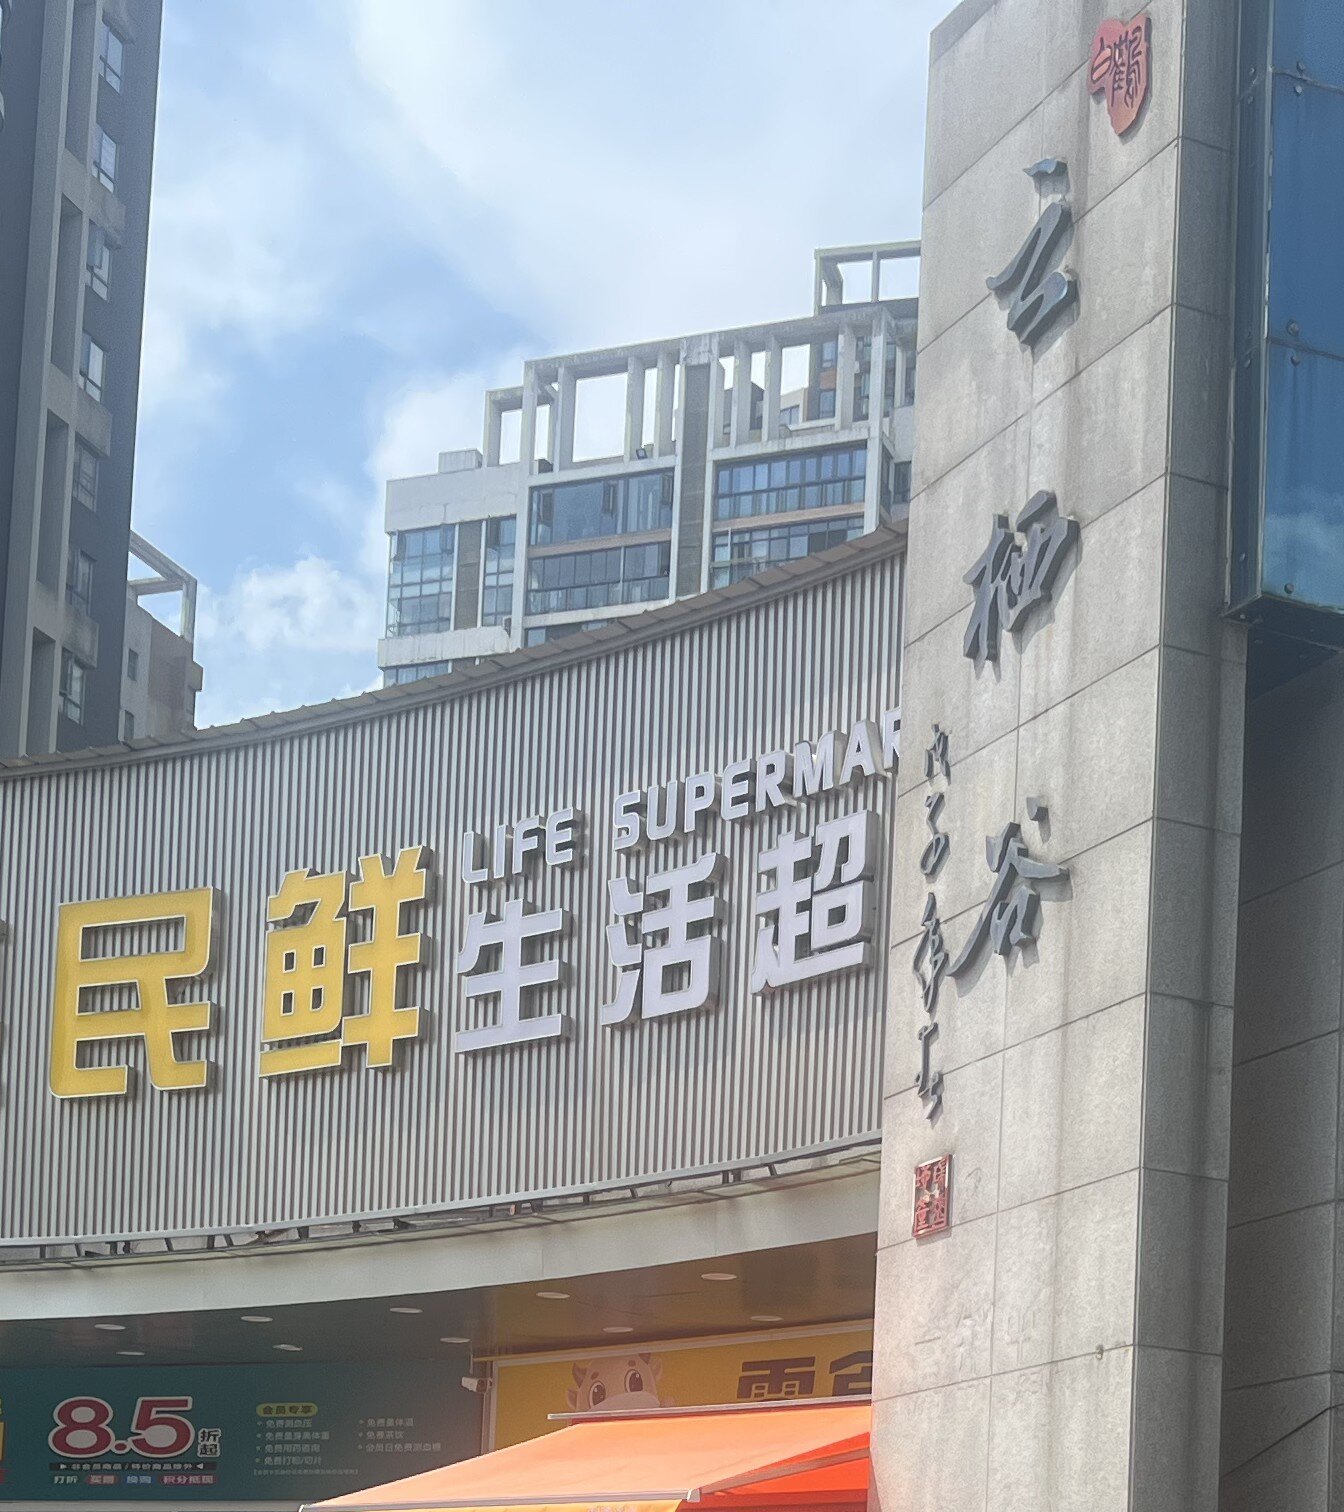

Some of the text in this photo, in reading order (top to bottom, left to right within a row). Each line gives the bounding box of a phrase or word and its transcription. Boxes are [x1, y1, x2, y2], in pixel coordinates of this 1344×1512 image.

[461, 806, 579, 885] LIFE
[455, 809, 879, 1053] 生活超
[48, 1396, 195, 1458] 8.5
